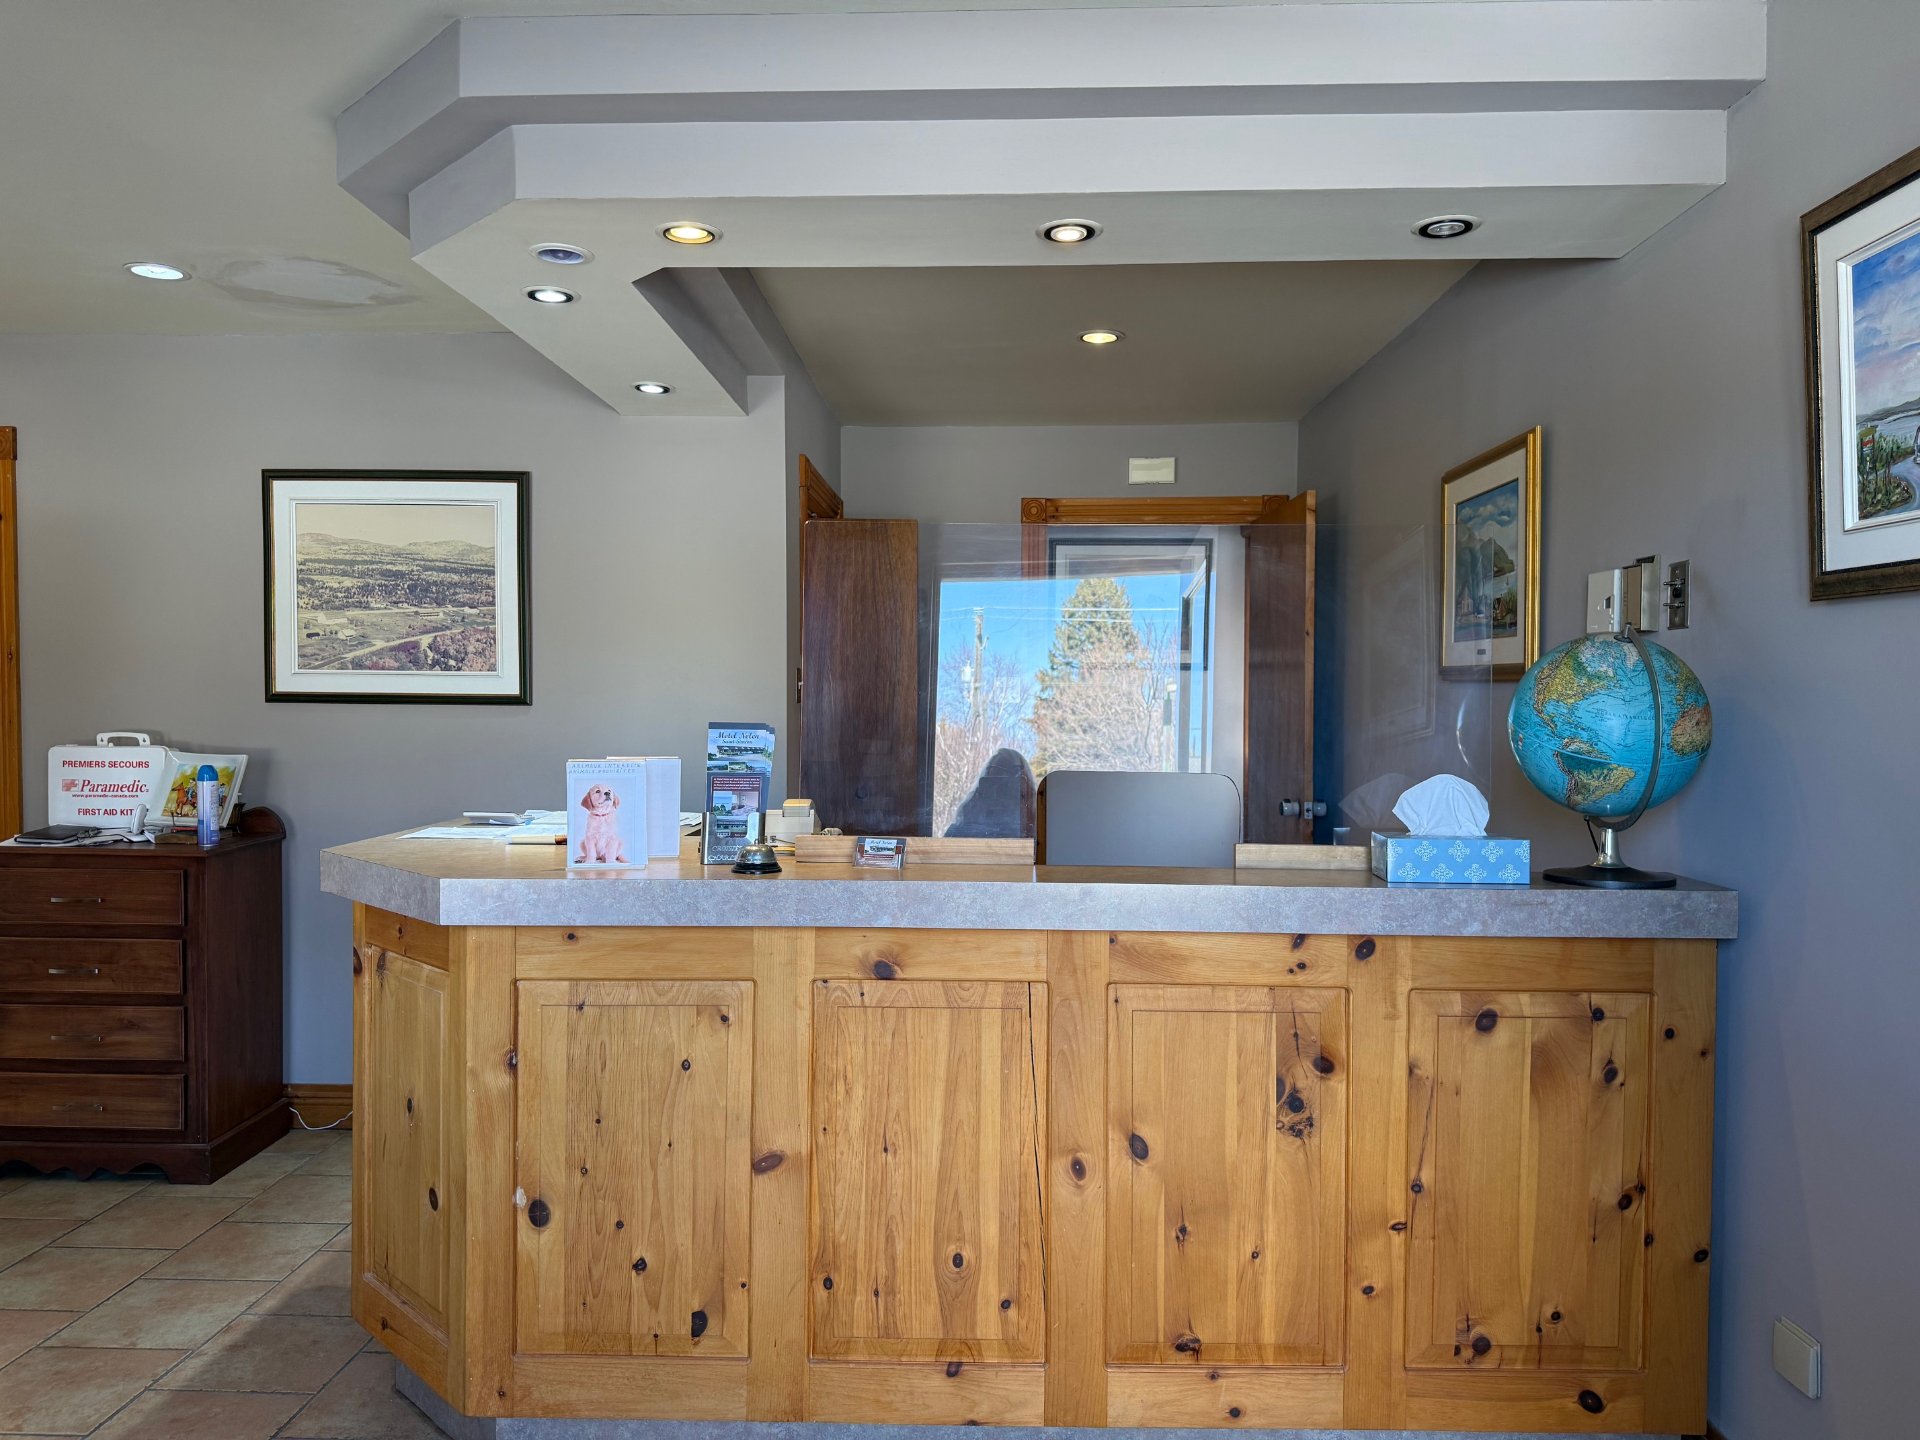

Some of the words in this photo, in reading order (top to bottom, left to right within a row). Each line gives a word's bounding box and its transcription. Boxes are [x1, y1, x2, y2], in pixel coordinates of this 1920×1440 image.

[62, 760, 106, 768] PREMIERS
[107, 760, 150, 769] SECOURS
[80, 779, 147, 793] Paramedic
[77, 808, 102, 816] FIRST
[103, 808, 118, 816] AID
[120, 808, 135, 816] KIT
